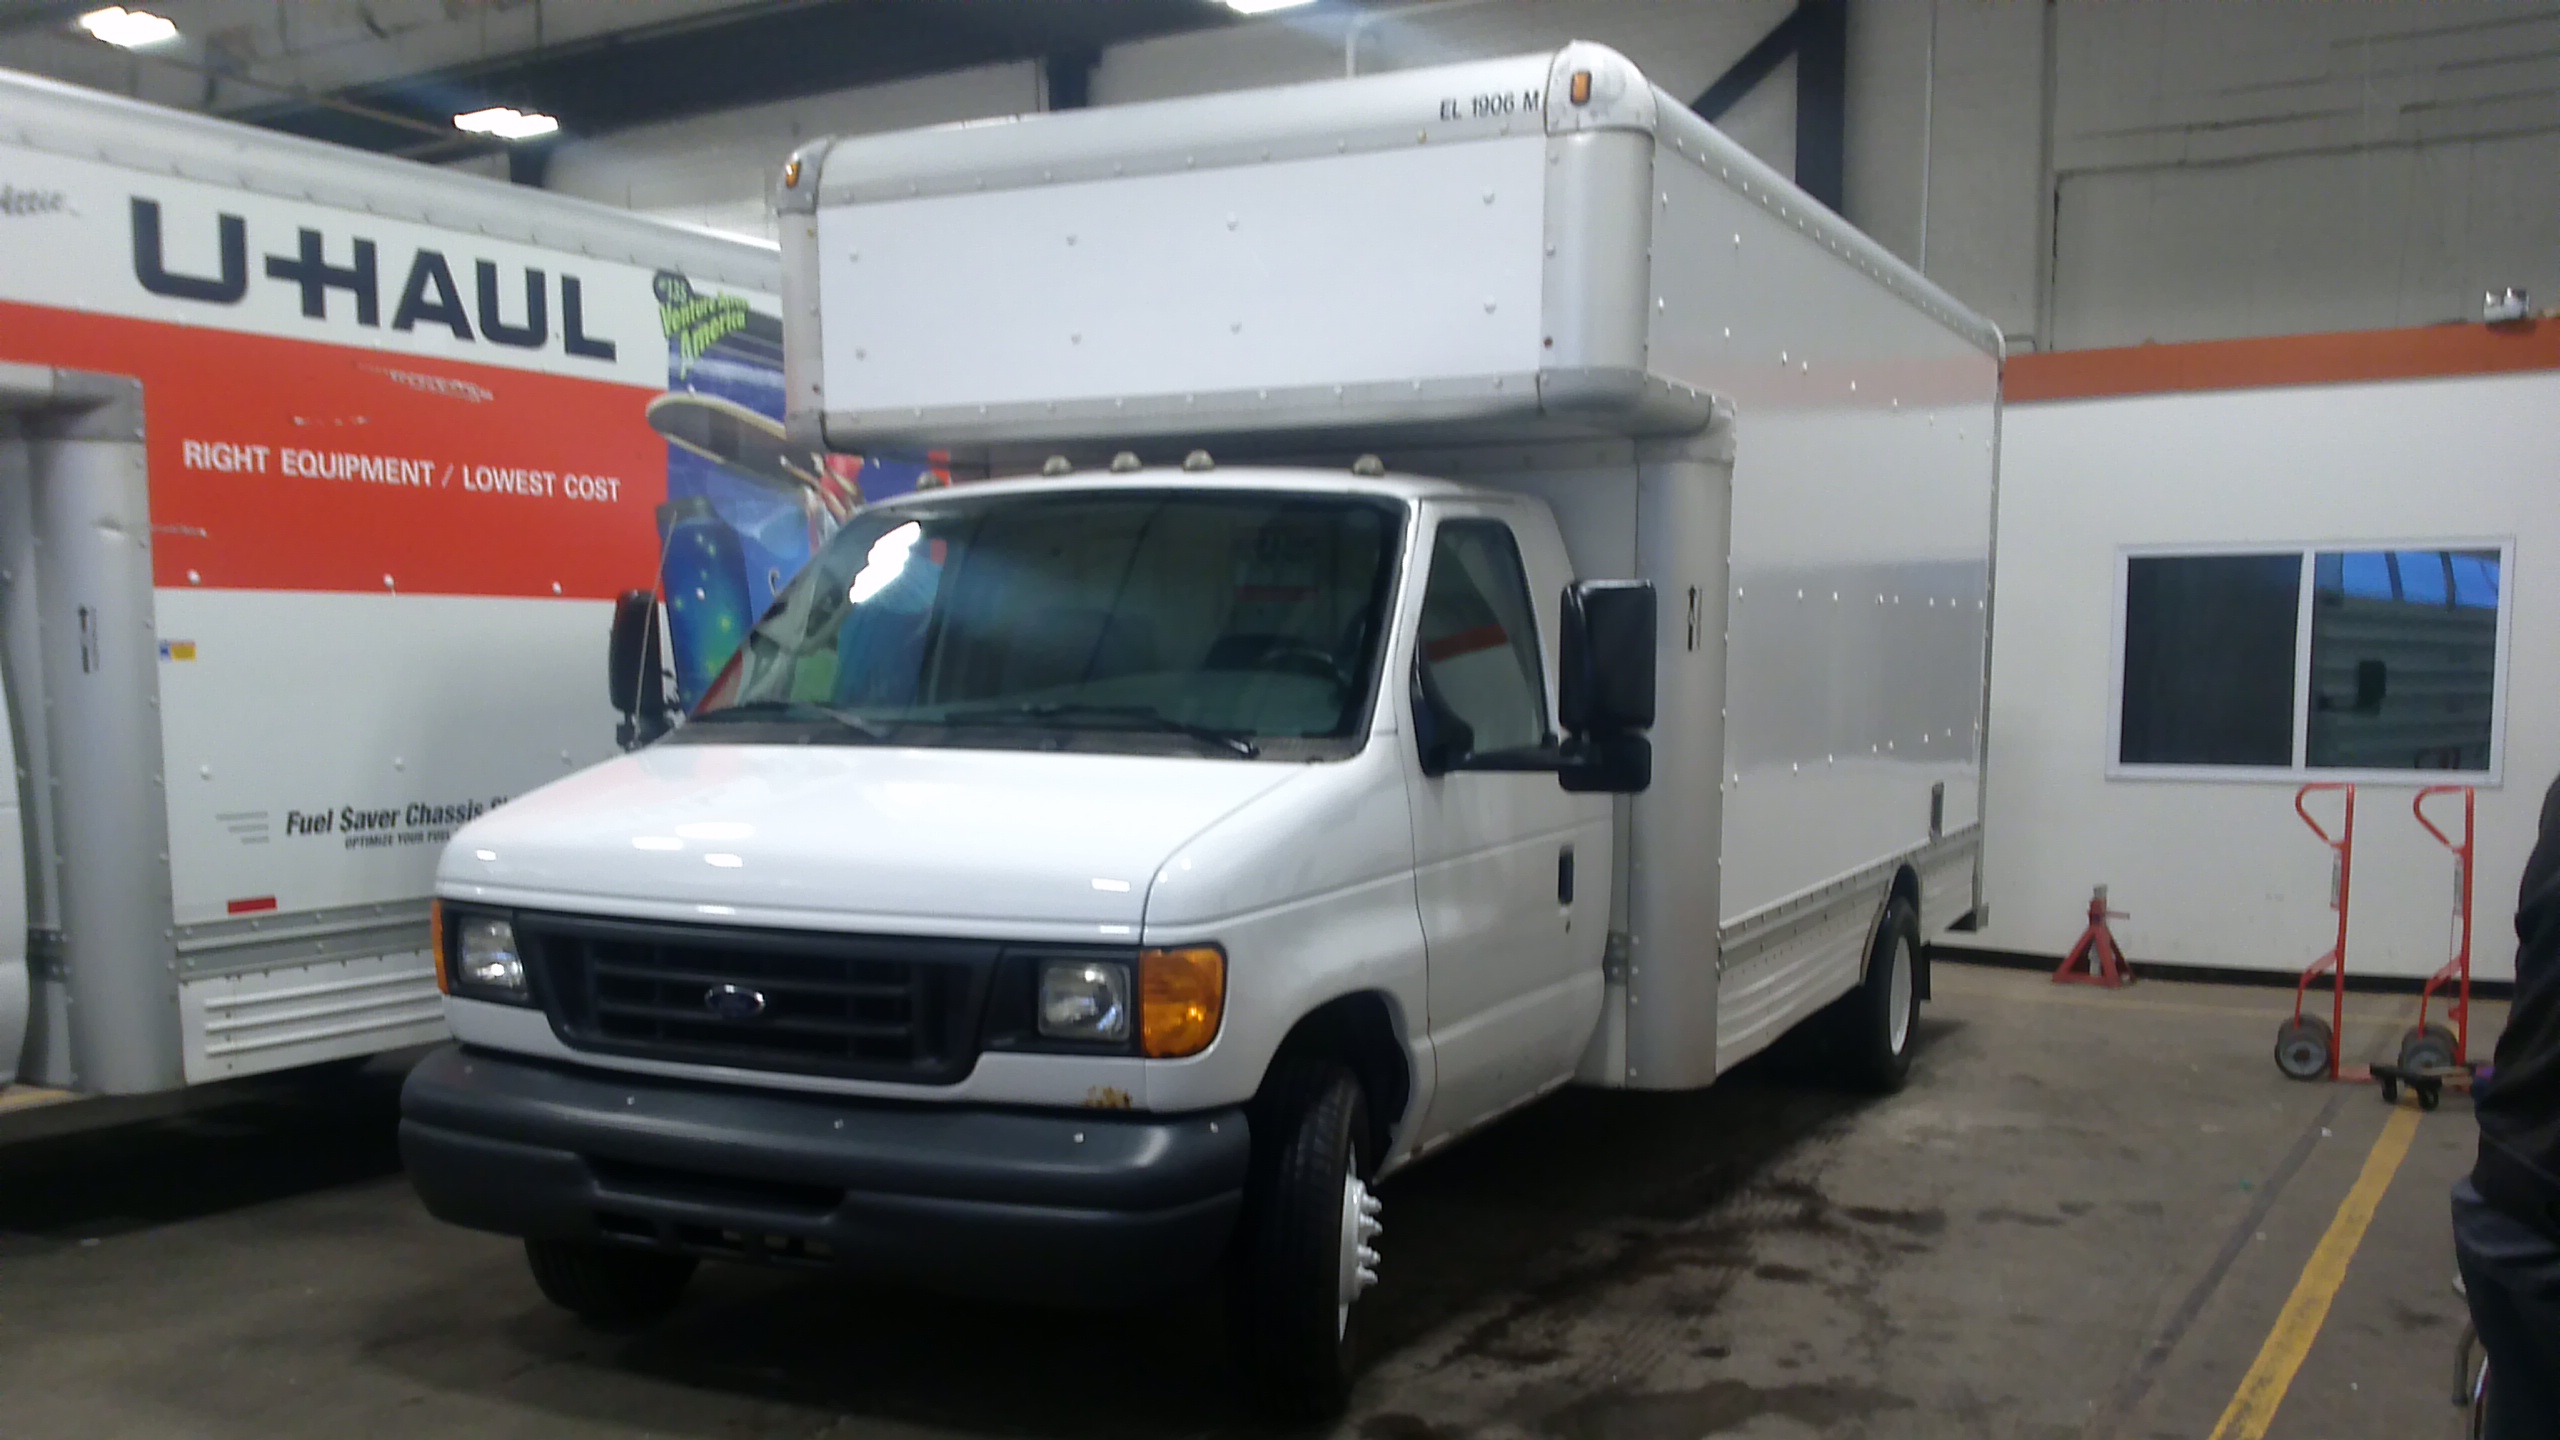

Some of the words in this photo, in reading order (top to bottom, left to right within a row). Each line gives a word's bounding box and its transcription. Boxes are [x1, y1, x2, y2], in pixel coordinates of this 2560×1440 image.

[1440, 99, 1462, 121] EL
[1472, 91, 1515, 118] 1906
[1523, 90, 1541, 112] M
[130, 196, 617, 363] U-HAUL
[659, 295, 717, 338] Venture
[680, 310, 746, 379] America
[183, 438, 270, 474] RIGHT
[281, 447, 435, 488] EQUIPMENT
[463, 463, 557, 498] LOWEST
[564, 472, 621, 502] COST
[286, 808, 334, 836] Fuel
[405, 798, 483, 827] Chassis
[345, 832, 394, 850] OPTIMIZE
[397, 829, 424, 845] YOUR
[427, 828, 451, 843] FUEL
